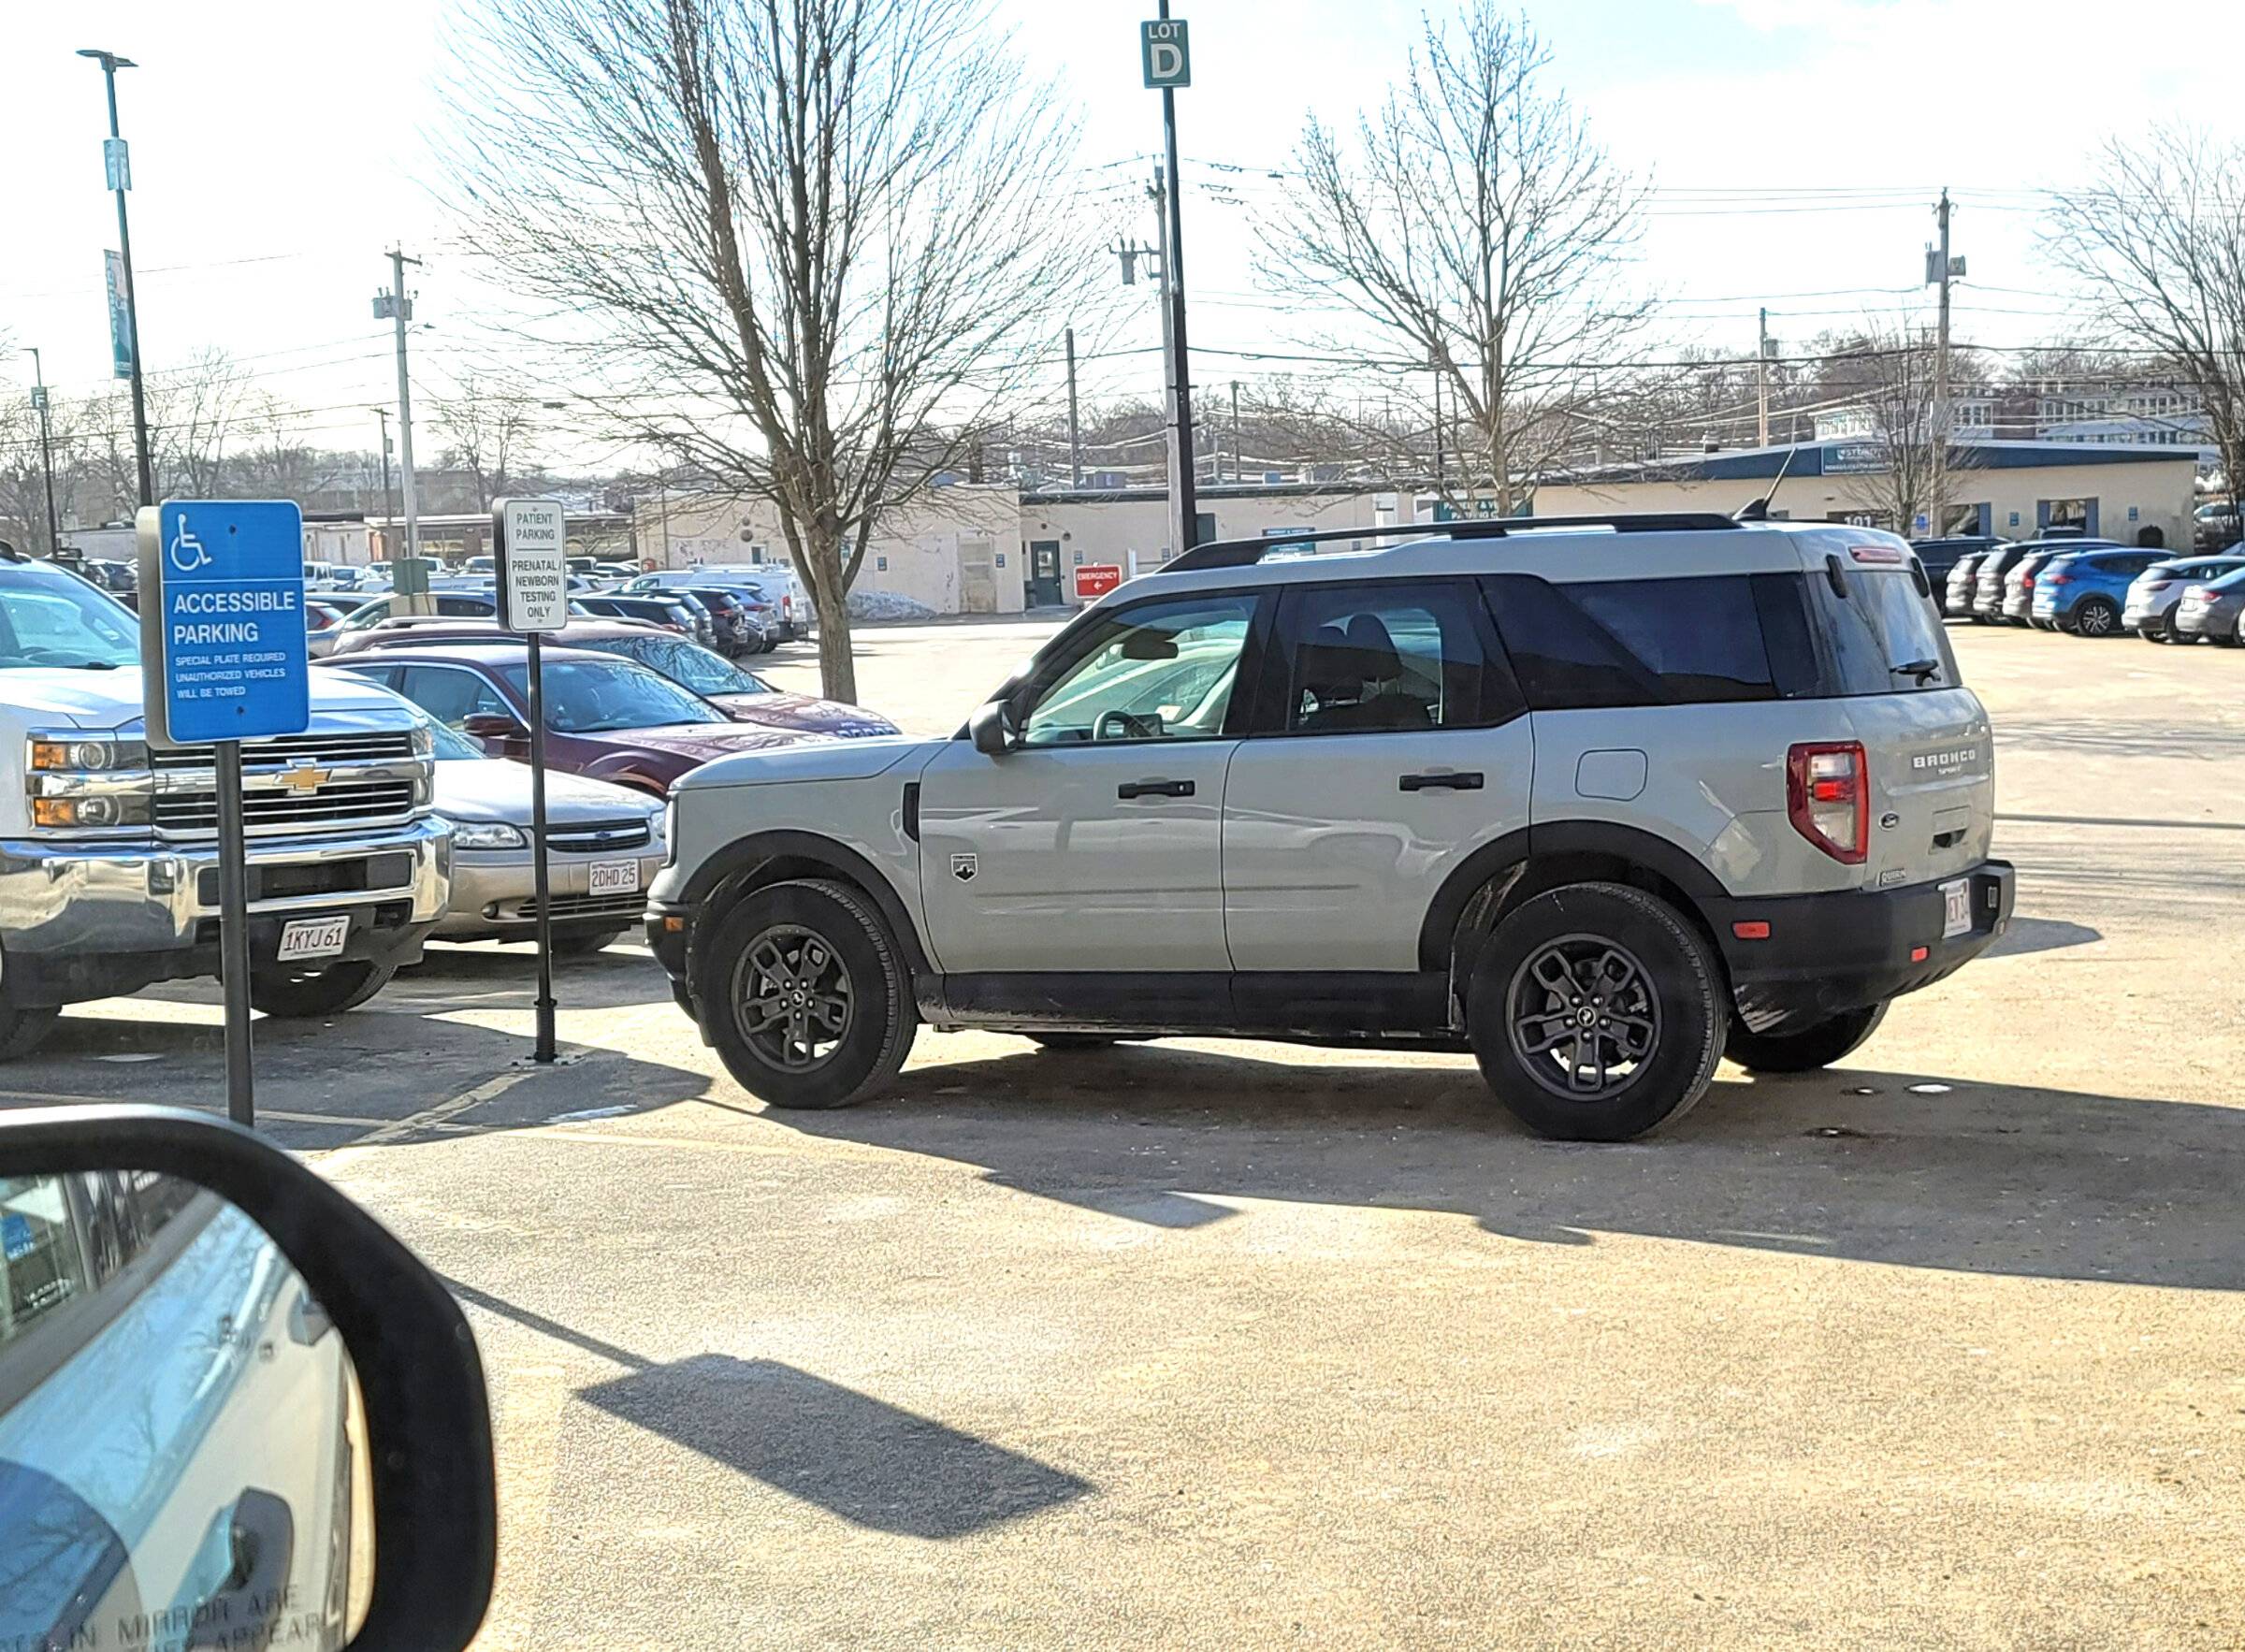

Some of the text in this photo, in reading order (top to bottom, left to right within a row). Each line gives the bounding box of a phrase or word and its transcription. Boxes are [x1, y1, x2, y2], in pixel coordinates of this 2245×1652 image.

[1148, 22, 1180, 38] LOT
[1151, 43, 1182, 79] D
[36, 394, 46, 408] F
[516, 513, 553, 525] PATIENT
[1844, 515, 1872, 528] 101
[515, 529, 555, 541] PARKING
[512, 559, 557, 572] PRENATAL
[515, 575, 559, 587] NEWBORN
[1077, 572, 1118, 581] EMERGENCY
[520, 590, 556, 602] TESTING
[173, 591, 297, 615] ACCESSIBLE
[527, 606, 551, 618] ONLY
[174, 622, 259, 645] PARKING
[175, 652, 286, 667] SPECIAL PLATE REQUIRED
[175, 668, 286, 683] UNAUTHORIZED VEHICLES
[177, 686, 246, 699] WILL BE TOWED
[1913, 749, 1976, 768] BRONCO
